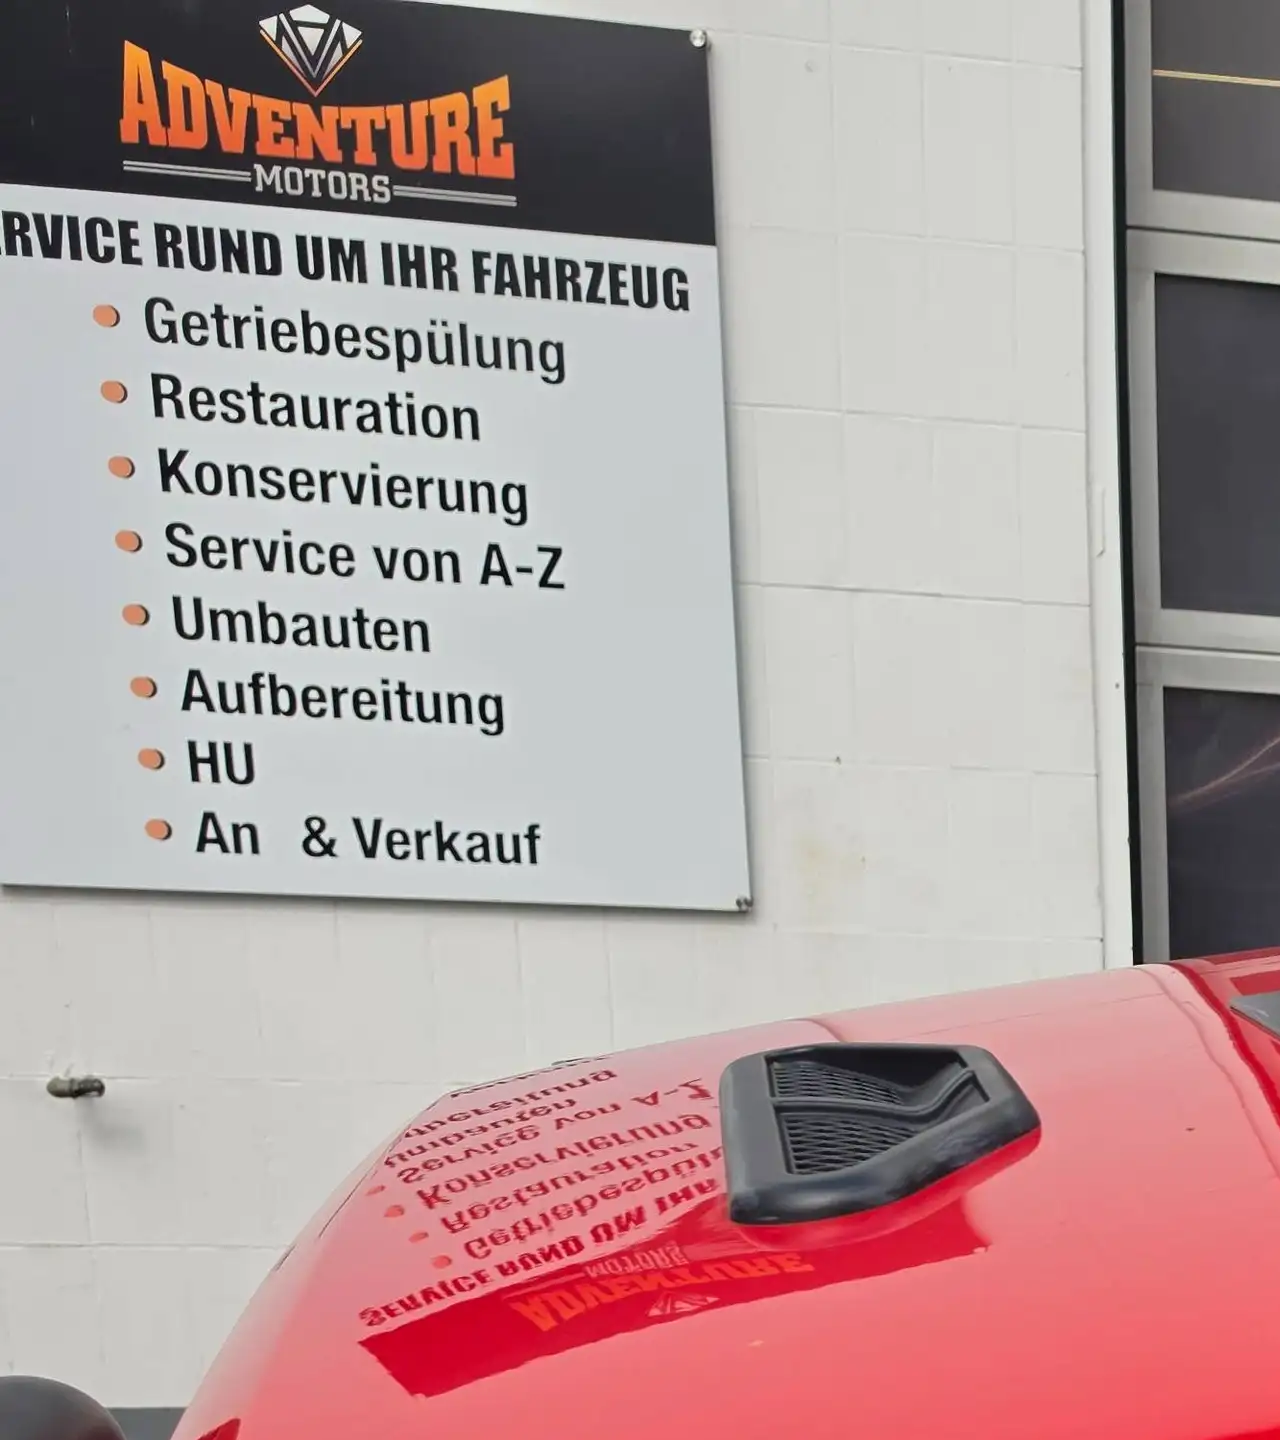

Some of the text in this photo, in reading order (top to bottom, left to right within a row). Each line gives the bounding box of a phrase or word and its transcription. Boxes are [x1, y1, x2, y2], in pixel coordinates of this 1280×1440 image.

[120, 40, 516, 181] ADVENTURE
[254, 164, 392, 204] MOTORS
[0, 210, 691, 312] RVICE RUND UM IHR FAHRZEUG
[144, 297, 567, 385] Getriebespülung
[150, 373, 481, 442] Restauration
[157, 448, 529, 526] Konservierung
[164, 523, 566, 590] Service von A-Z
[171, 596, 432, 654] Umbauten
[180, 669, 505, 737] Aufbereitung
[187, 740, 256, 786] HU
[195, 811, 541, 865] An & Verkauf
